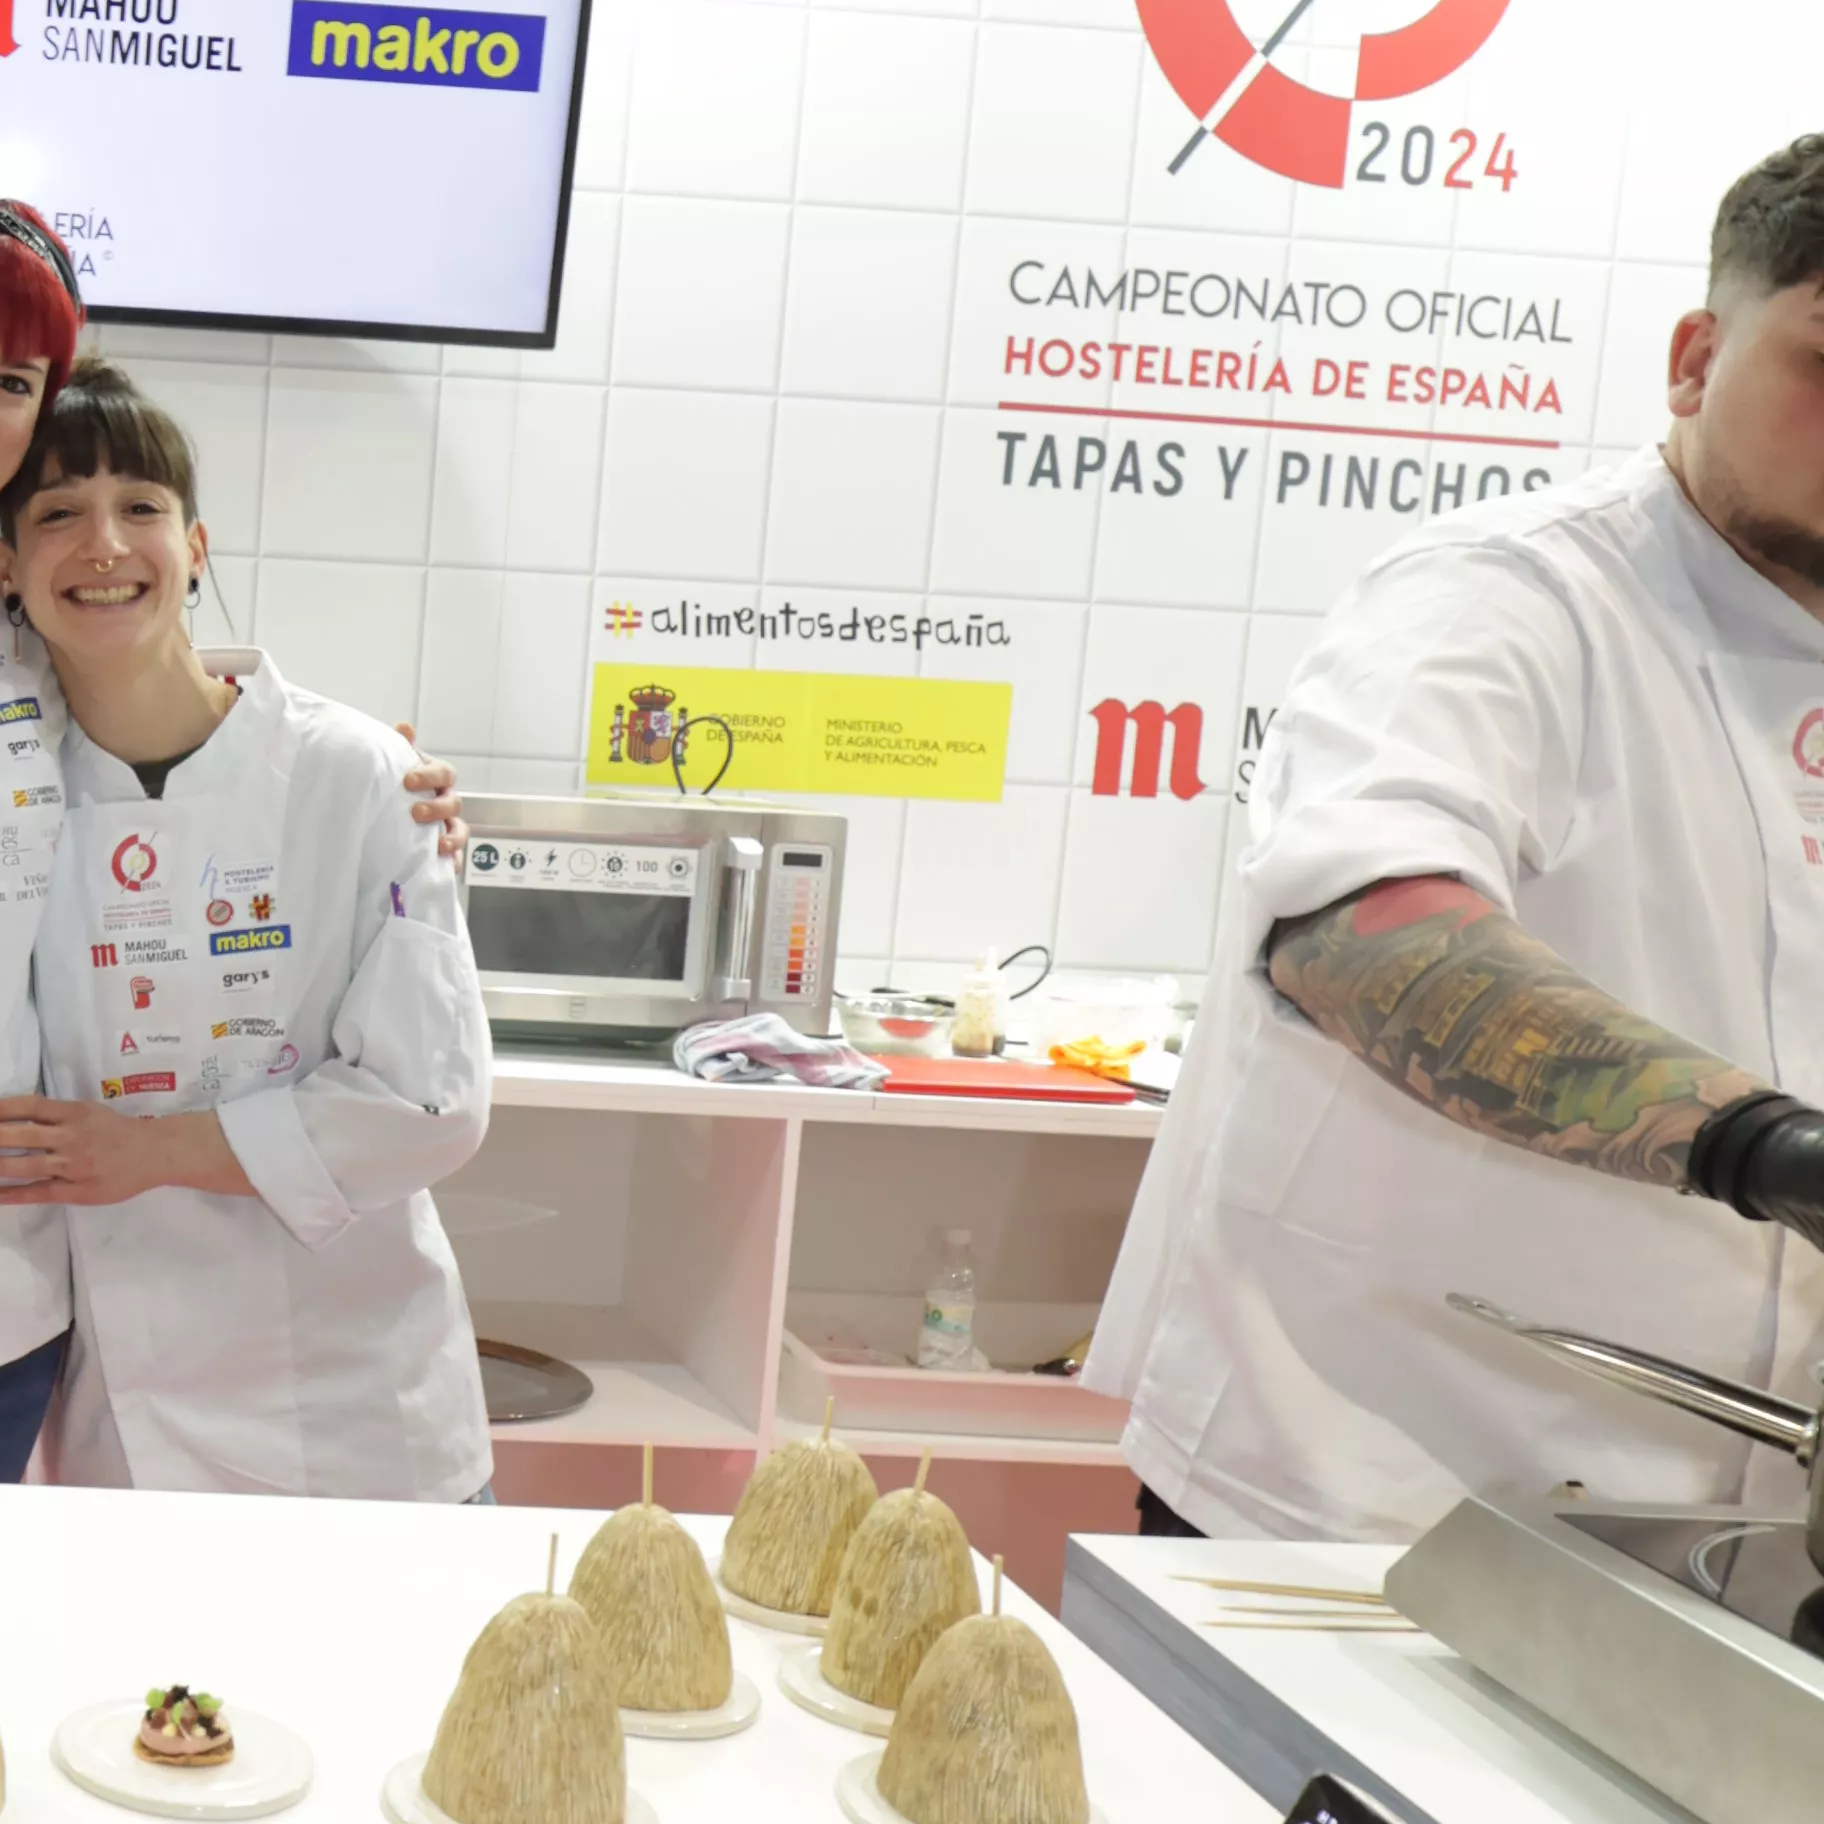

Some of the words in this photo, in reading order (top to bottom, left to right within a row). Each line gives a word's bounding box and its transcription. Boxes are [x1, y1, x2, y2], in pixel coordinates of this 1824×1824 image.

[43, 26, 241, 72] SANMIGUEL
[311, 15, 519, 78] makro
[1356, 122, 1518, 195] 2024
[1009, 260, 1367, 330] CAMPEONATO
[1385, 289, 1573, 345] OFICIAL
[1005, 337, 1293, 397] HOSTELERÍA
[1313, 359, 1368, 401] DE
[1386, 360, 1563, 416] ESPAÑA
[997, 431, 1185, 498] TAPAS
[1218, 446, 1248, 500] Y
[707, 729, 729, 741] DE
[732, 728, 783, 744] ESPAÑA
[826, 719, 902, 733] MINISTERIO
[826, 735, 843, 747] DE
[947, 741, 986, 754] PESCA
[825, 752, 833, 761] Y
[636, 860, 658, 873] 100
[125, 939, 166, 952] MAHOU
[216, 930, 284, 952] makro
